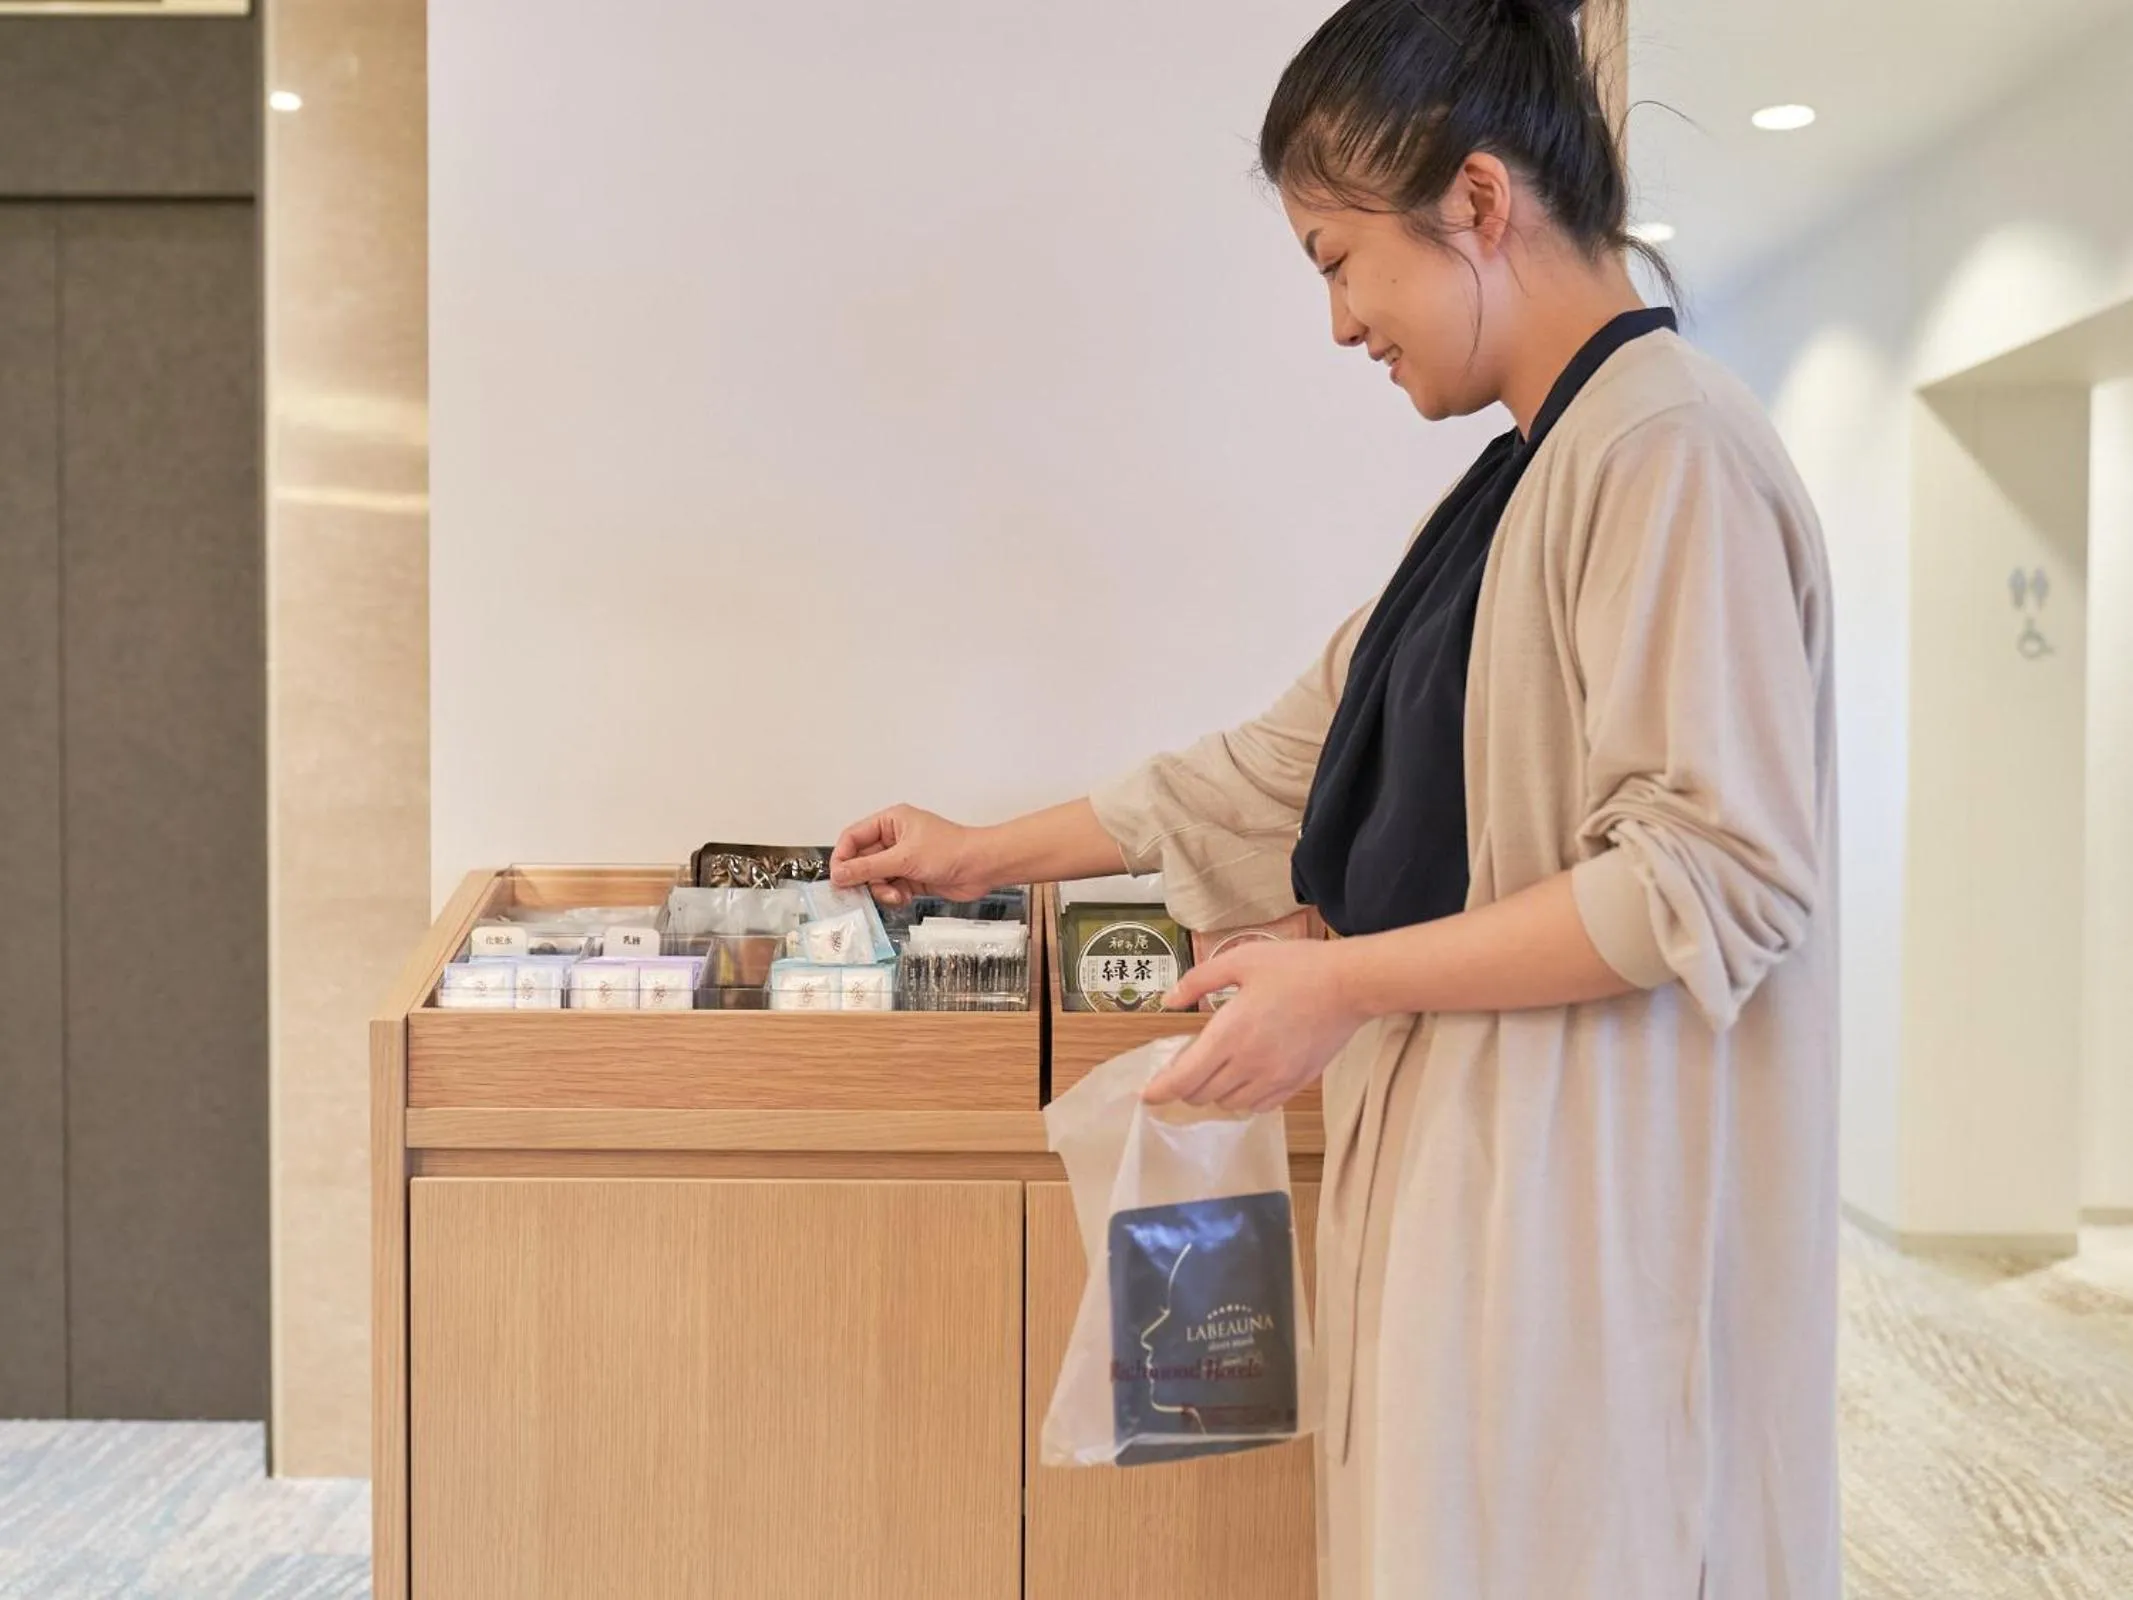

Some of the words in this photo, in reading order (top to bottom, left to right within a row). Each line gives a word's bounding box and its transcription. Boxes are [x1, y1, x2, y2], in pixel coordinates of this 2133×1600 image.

[485, 935, 513, 945] 化粧水
[1102, 959, 1152, 981] 緑茶
[1187, 1314, 1274, 1342] LABEAUNA
